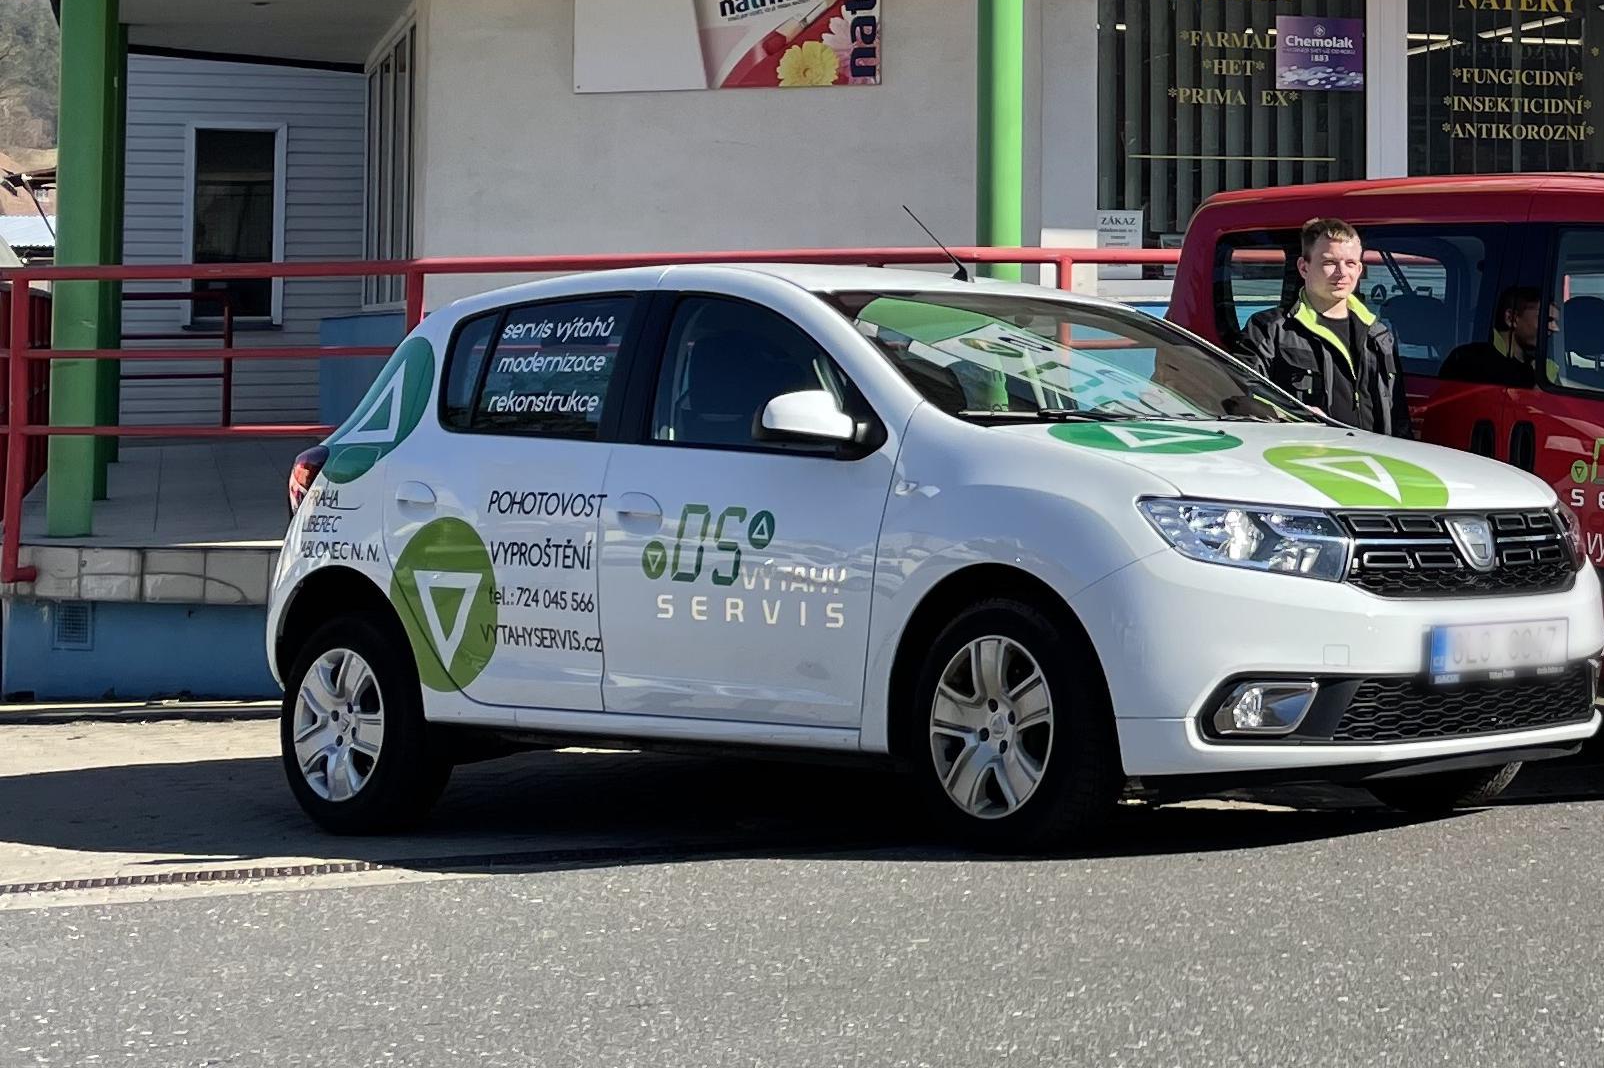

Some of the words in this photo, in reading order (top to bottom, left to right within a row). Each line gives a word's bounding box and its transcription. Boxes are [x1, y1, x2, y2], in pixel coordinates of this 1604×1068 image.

[1285, 35, 1354, 50] Chemolak
[1213, 59, 1255, 77] HET
[1461, 66, 1577, 87] FUNGICIDNÍ
[1177, 87, 1247, 106] PRIMA
[1453, 94, 1584, 115] INSEKTICIDNÍ
[1451, 121, 1587, 141] ANTIKOROZNÍ
[1101, 215, 1136, 226] ZÁKAZ
[502, 319, 554, 339] servis
[556, 316, 615, 343] výtahů
[497, 351, 606, 372] modernizace
[488, 390, 600, 412] rekonstrukce
[487, 489, 608, 519] POHOTOVOST
[300, 540, 350, 560] ABLONEC
[489, 537, 593, 571] VYPROŠTĚNÍ
[543, 589, 568, 611] 045
[571, 592, 595, 613] 566
[656, 594, 845, 629] SERVIS
[479, 622, 604, 653] VYTAHYSERVIS.cz
